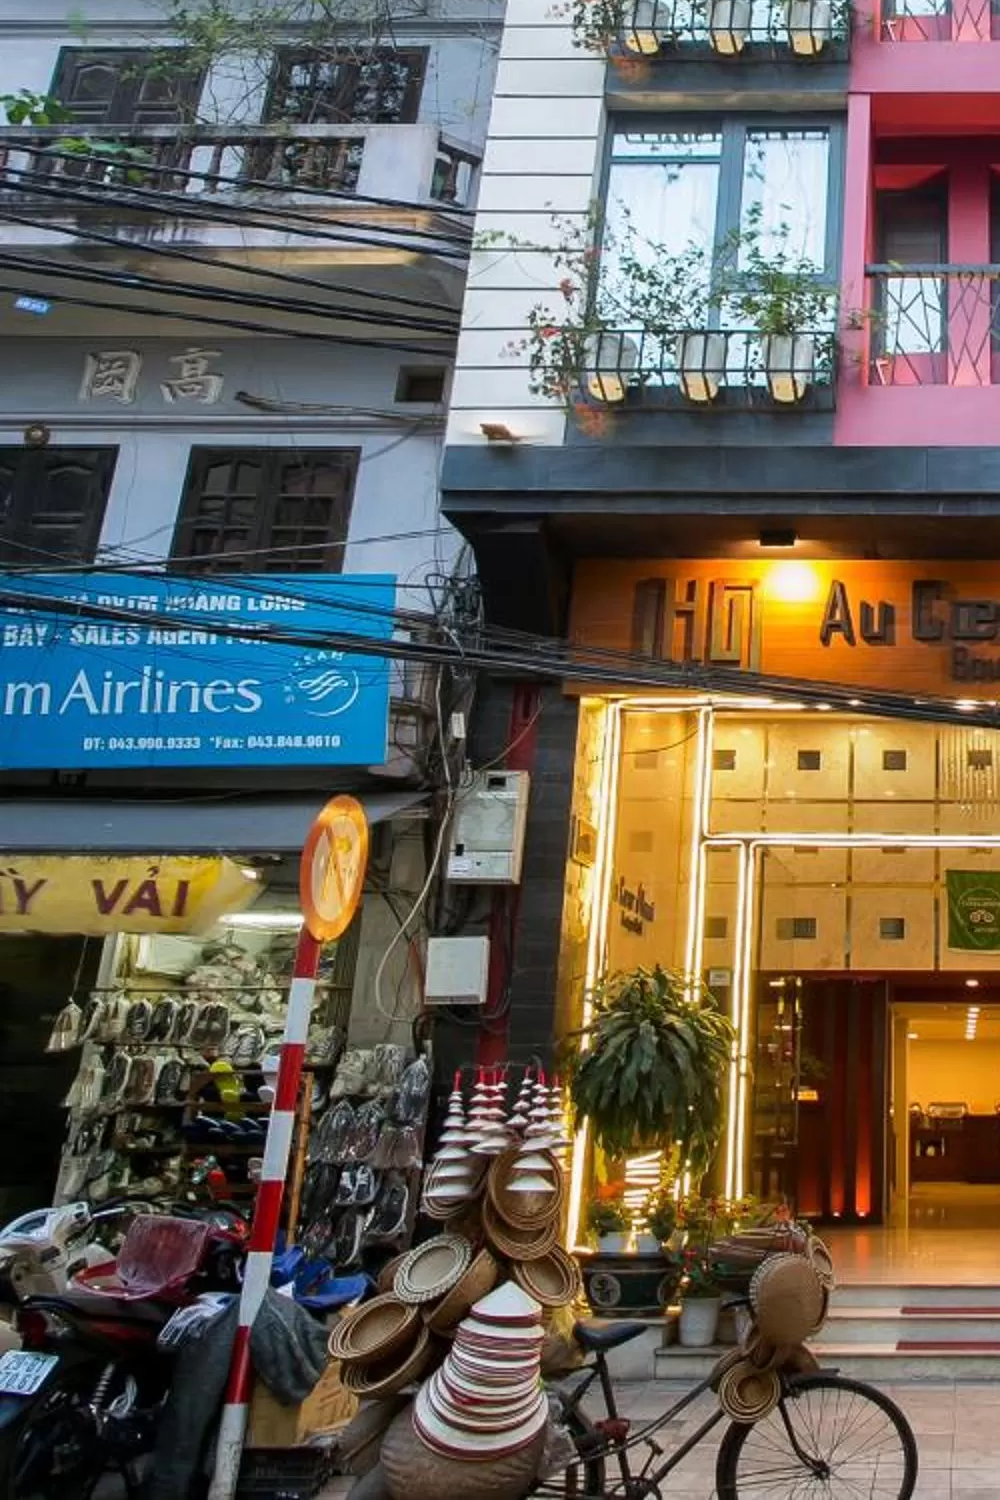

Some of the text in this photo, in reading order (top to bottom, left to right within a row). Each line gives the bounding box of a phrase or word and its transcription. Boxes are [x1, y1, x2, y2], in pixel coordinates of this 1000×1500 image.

[70, 624, 141, 645] SALES
[820, 579, 896, 646] Au
[59, 665, 263, 715] Airlines
[91, 865, 190, 917] VẢI
